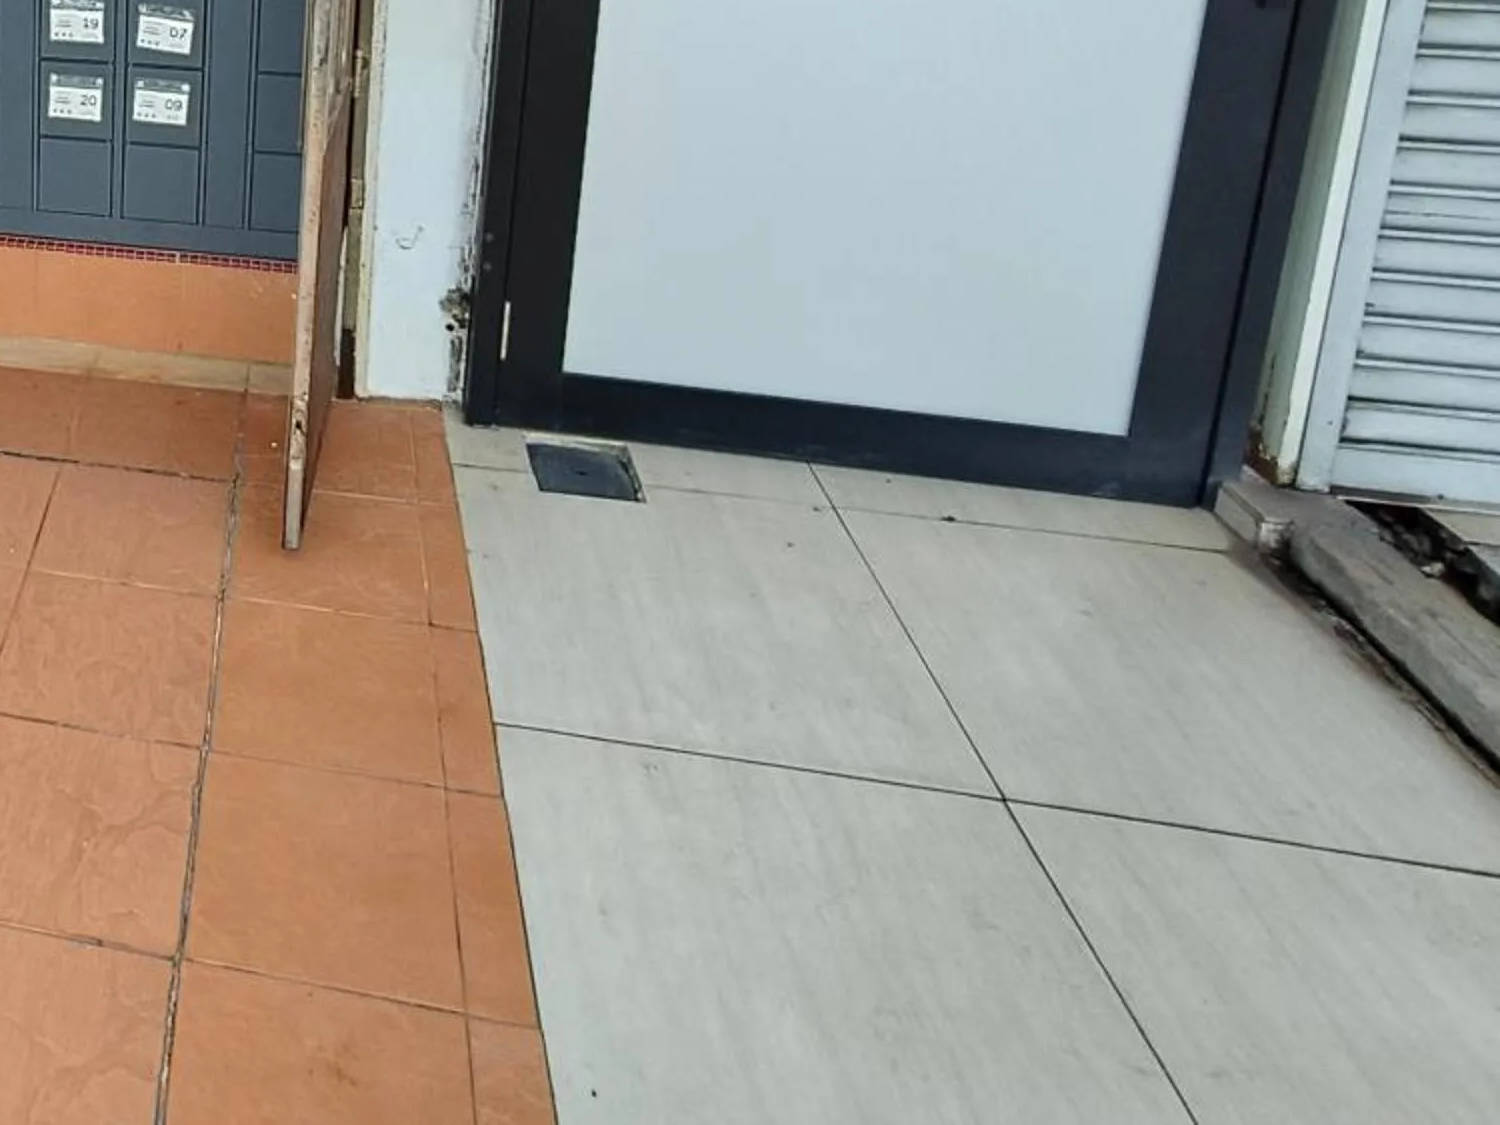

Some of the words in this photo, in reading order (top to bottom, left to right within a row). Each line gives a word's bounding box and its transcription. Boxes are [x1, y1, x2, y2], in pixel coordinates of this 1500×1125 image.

[83, 18, 99, 29] 19
[169, 26, 188, 39] 07
[80, 94, 97, 106] 20
[165, 98, 183, 111] 09
